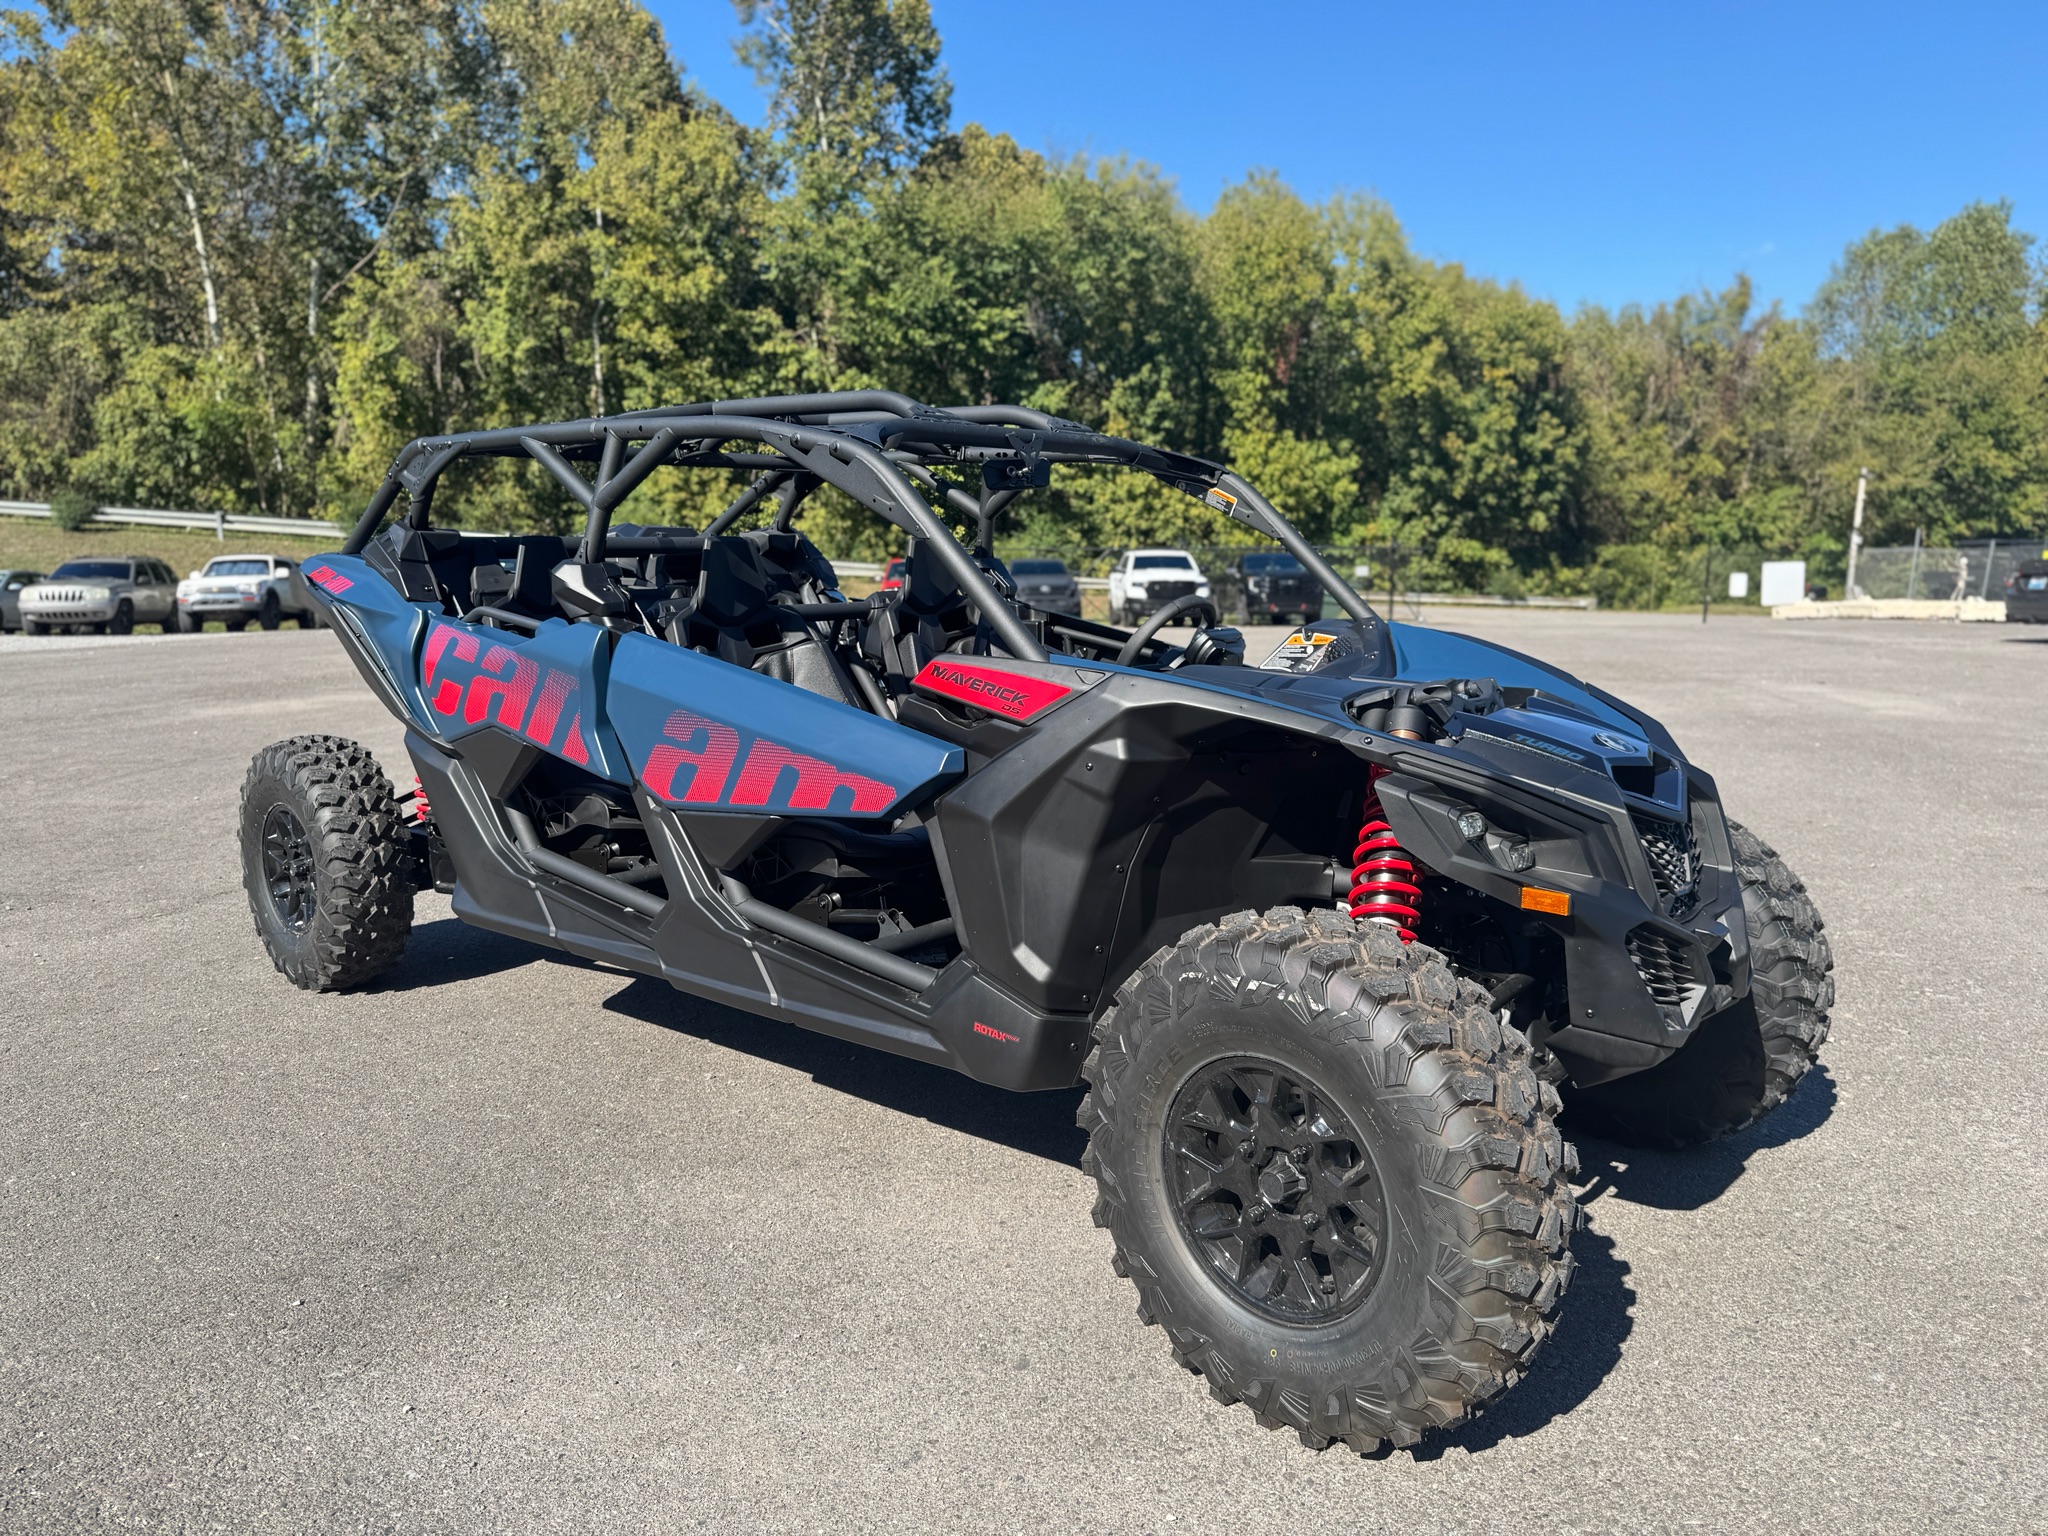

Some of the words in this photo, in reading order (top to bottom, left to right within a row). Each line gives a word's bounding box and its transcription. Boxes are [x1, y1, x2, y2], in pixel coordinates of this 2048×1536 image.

[930, 664, 1031, 707] MAVERICK
[1002, 704, 1022, 714] DS
[642, 709, 898, 811] am
[1515, 734, 1585, 761] TURBO
[974, 1022, 1006, 1041] ROTAX
[1133, 1044, 1185, 1133] FORCE
[1225, 1315, 1253, 1341] RADIAL
